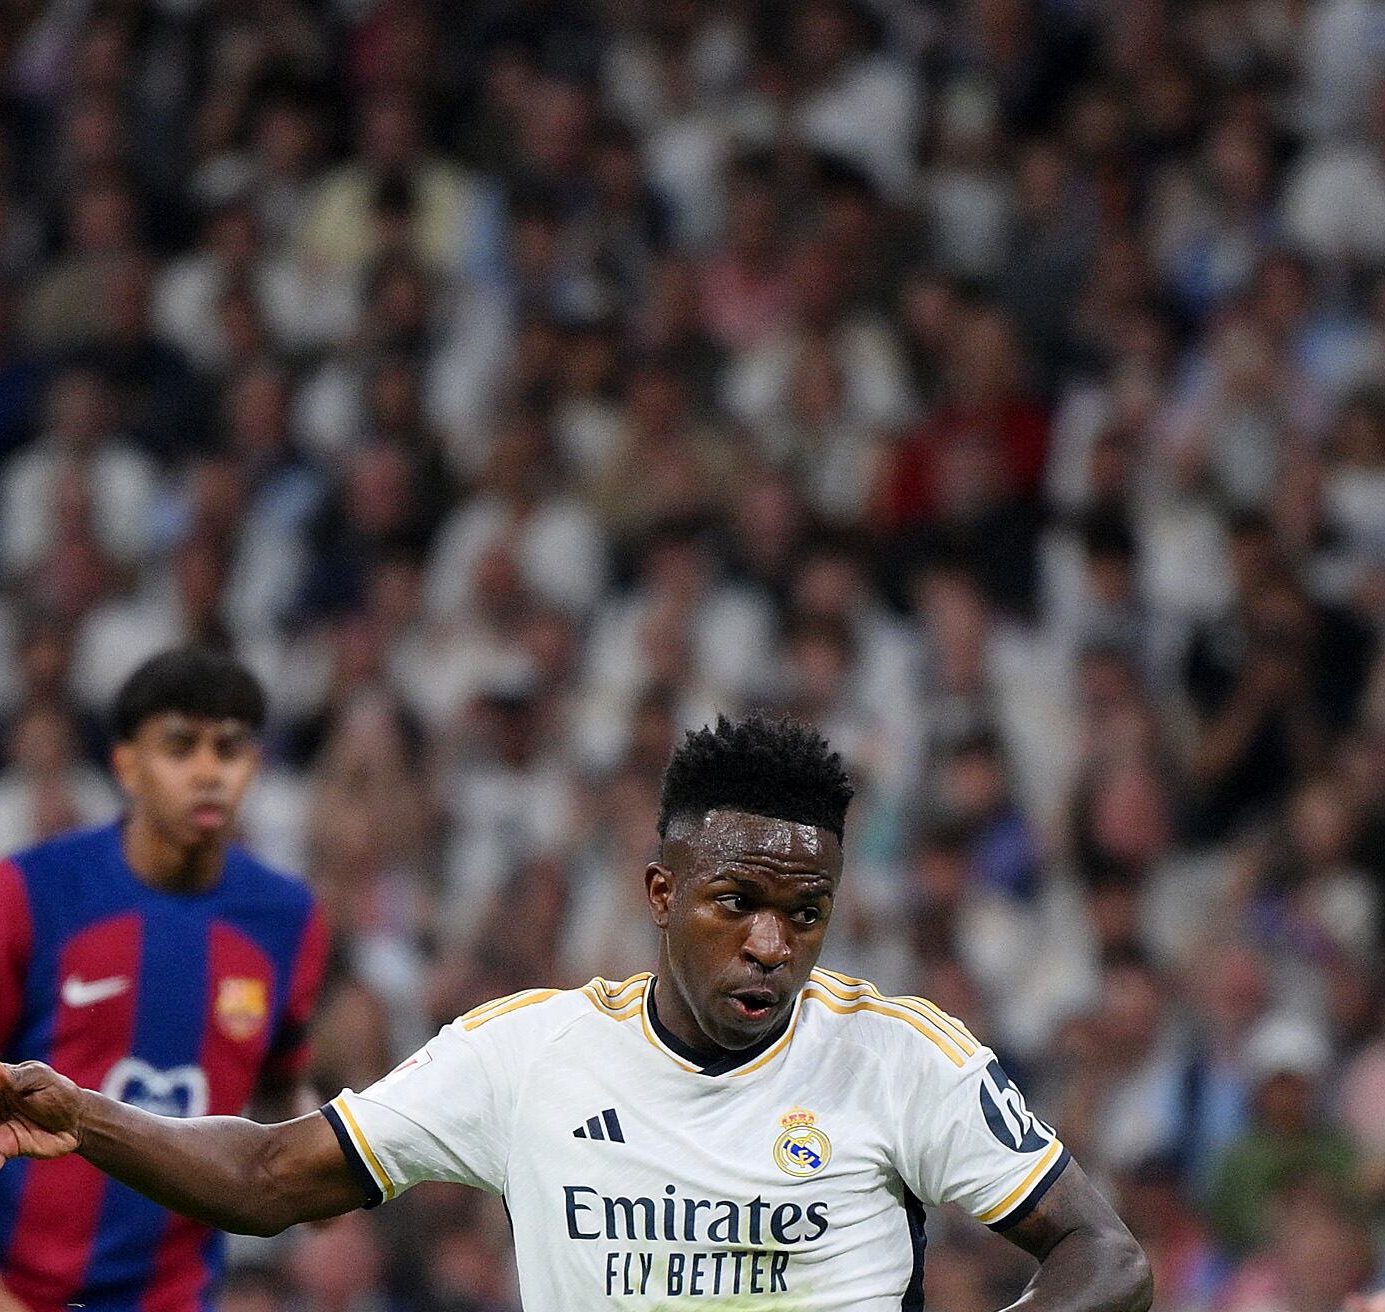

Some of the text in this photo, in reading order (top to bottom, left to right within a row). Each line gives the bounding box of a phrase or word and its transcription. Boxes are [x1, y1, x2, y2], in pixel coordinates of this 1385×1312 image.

[563, 1184, 829, 1245] Emirates
[606, 1250, 789, 1296] FLY BETTER
